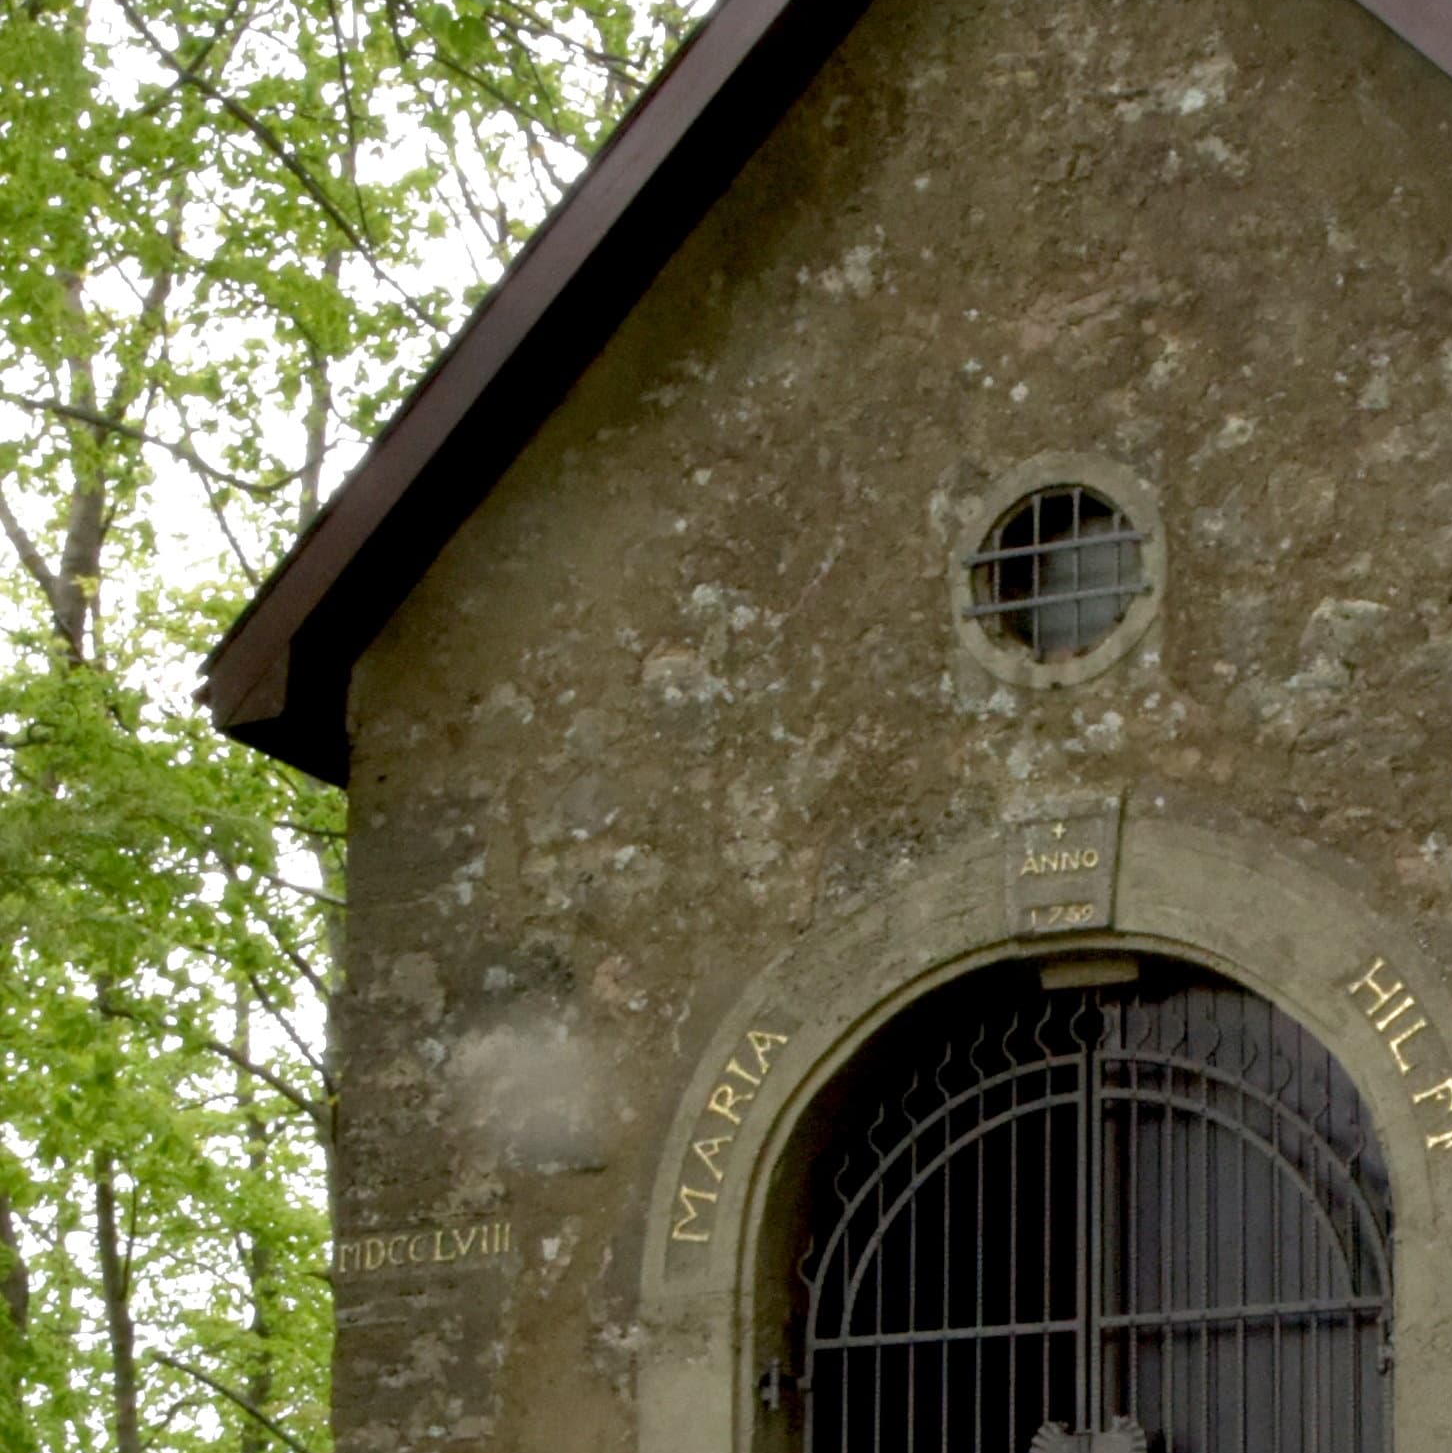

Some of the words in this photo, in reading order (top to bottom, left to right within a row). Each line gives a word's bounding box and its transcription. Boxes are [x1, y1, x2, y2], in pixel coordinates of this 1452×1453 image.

[1020, 848, 1099, 876] ANNO
[671, 1030, 789, 1242] MARIA
[338, 1222, 512, 1273] MDCCLVIII
